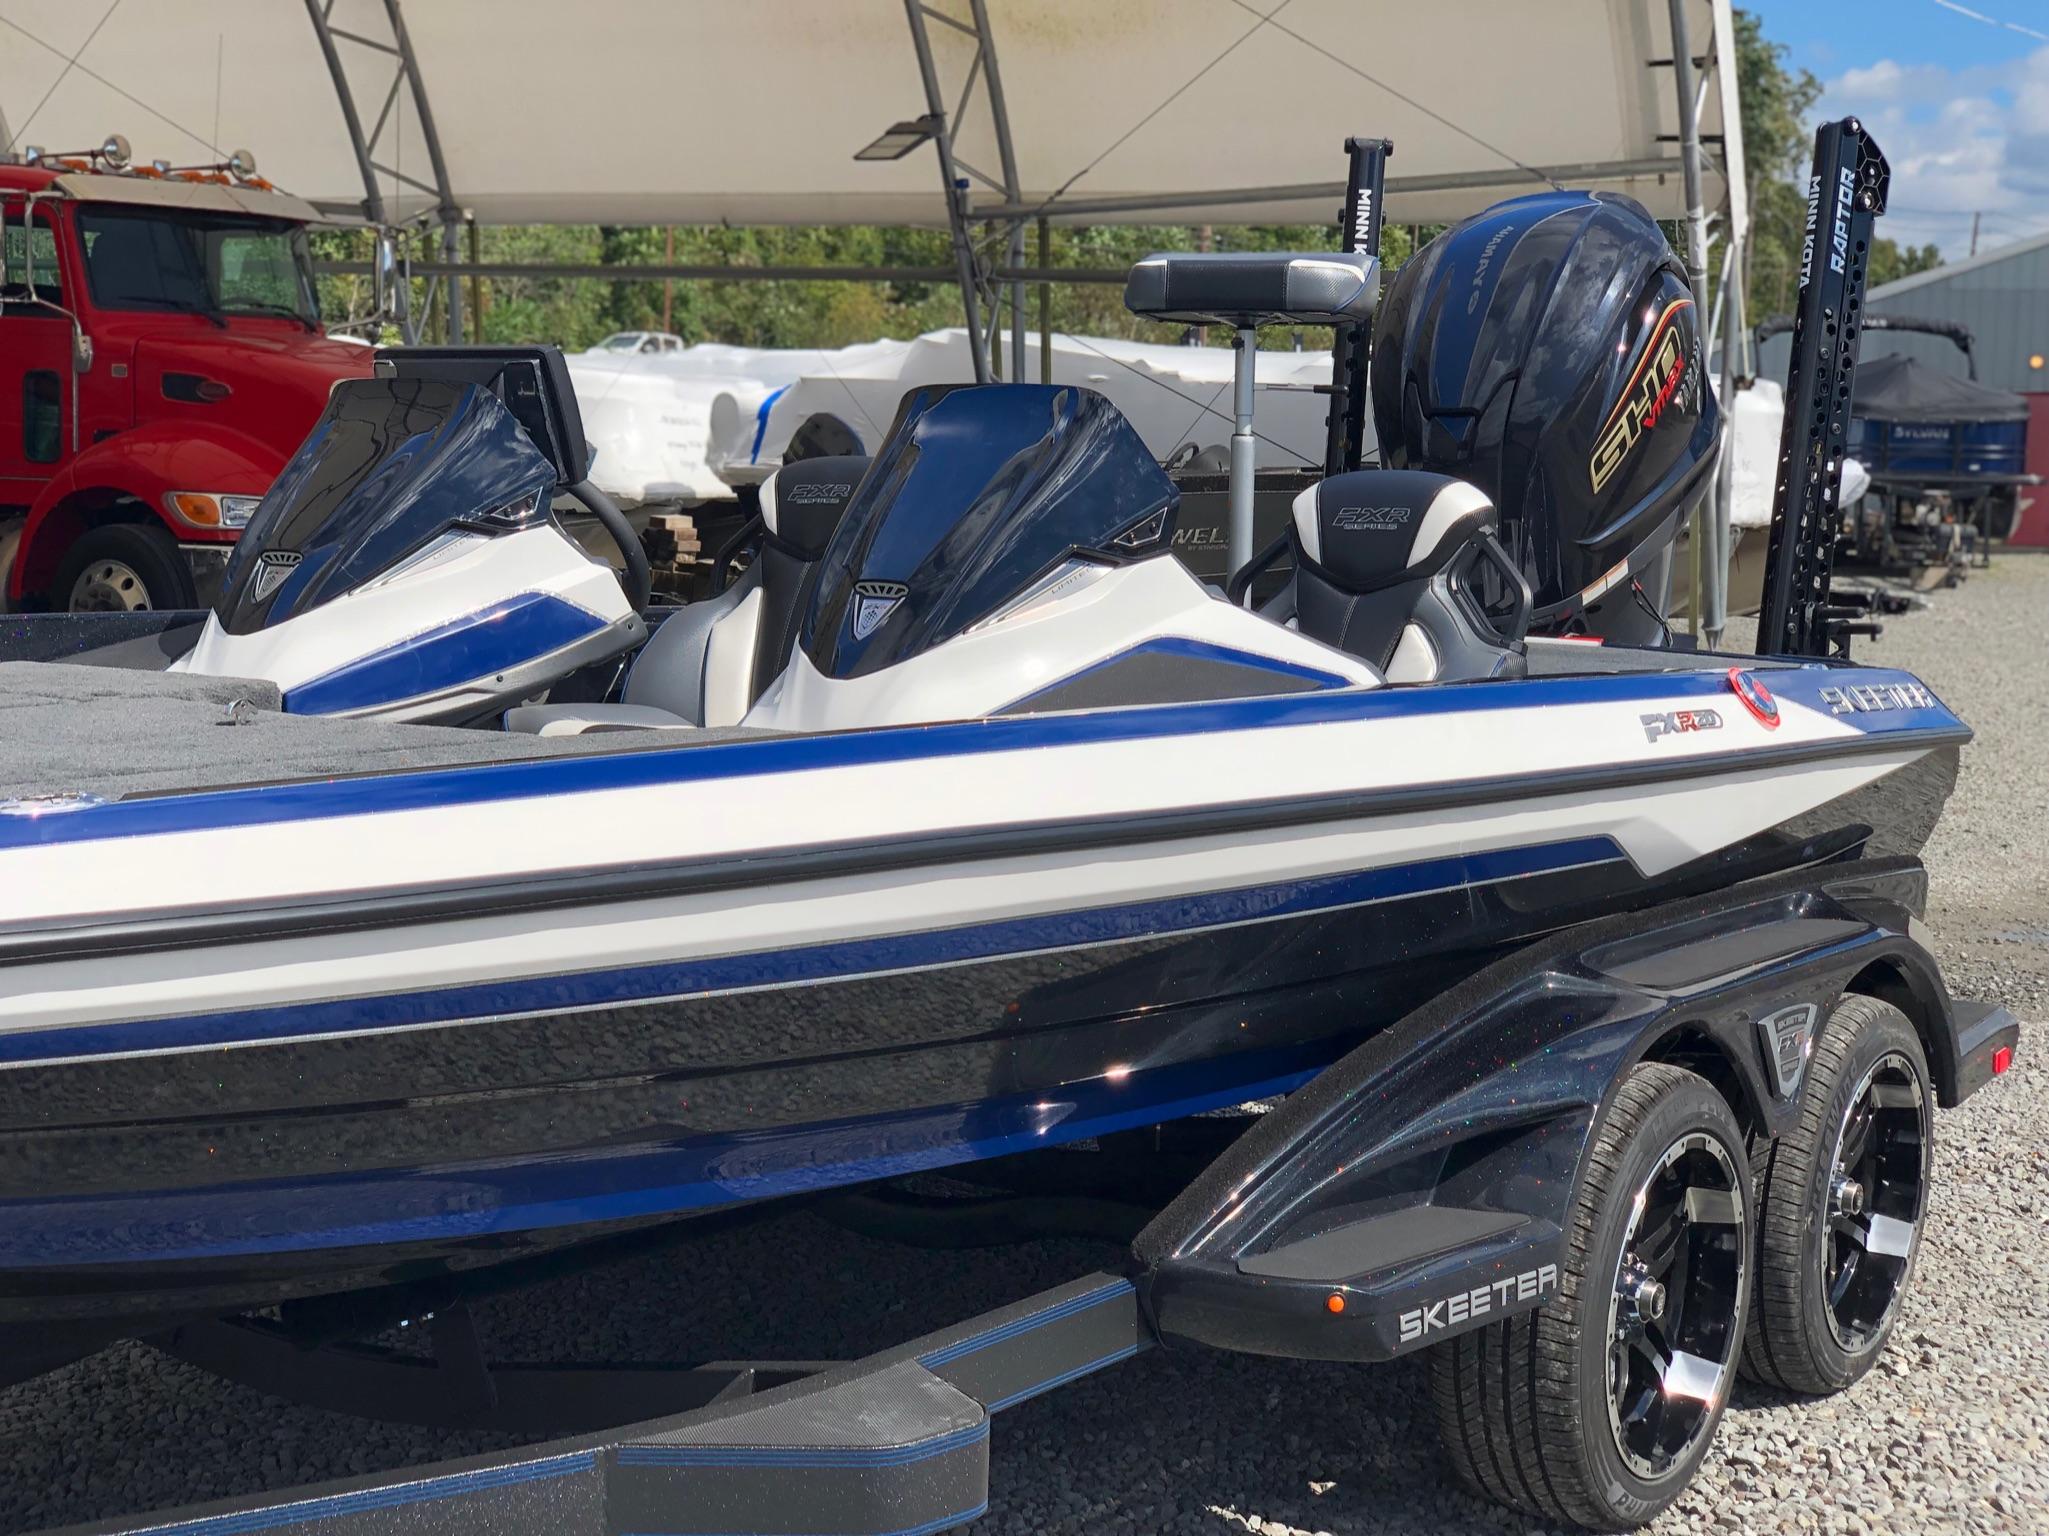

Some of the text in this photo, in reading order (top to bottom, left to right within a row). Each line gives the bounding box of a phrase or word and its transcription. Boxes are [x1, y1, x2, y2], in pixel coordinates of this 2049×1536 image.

[1355, 189, 1372, 239] MINN
[1800, 176, 1821, 288] MINN KOTA
[1831, 167, 1855, 275] RAPTOR
[787, 484, 851, 501] FXR
[1332, 507, 1411, 526] FXR
[1818, 682, 1937, 716] SKEETER
[1400, 1263, 1557, 1343] SKEETER
